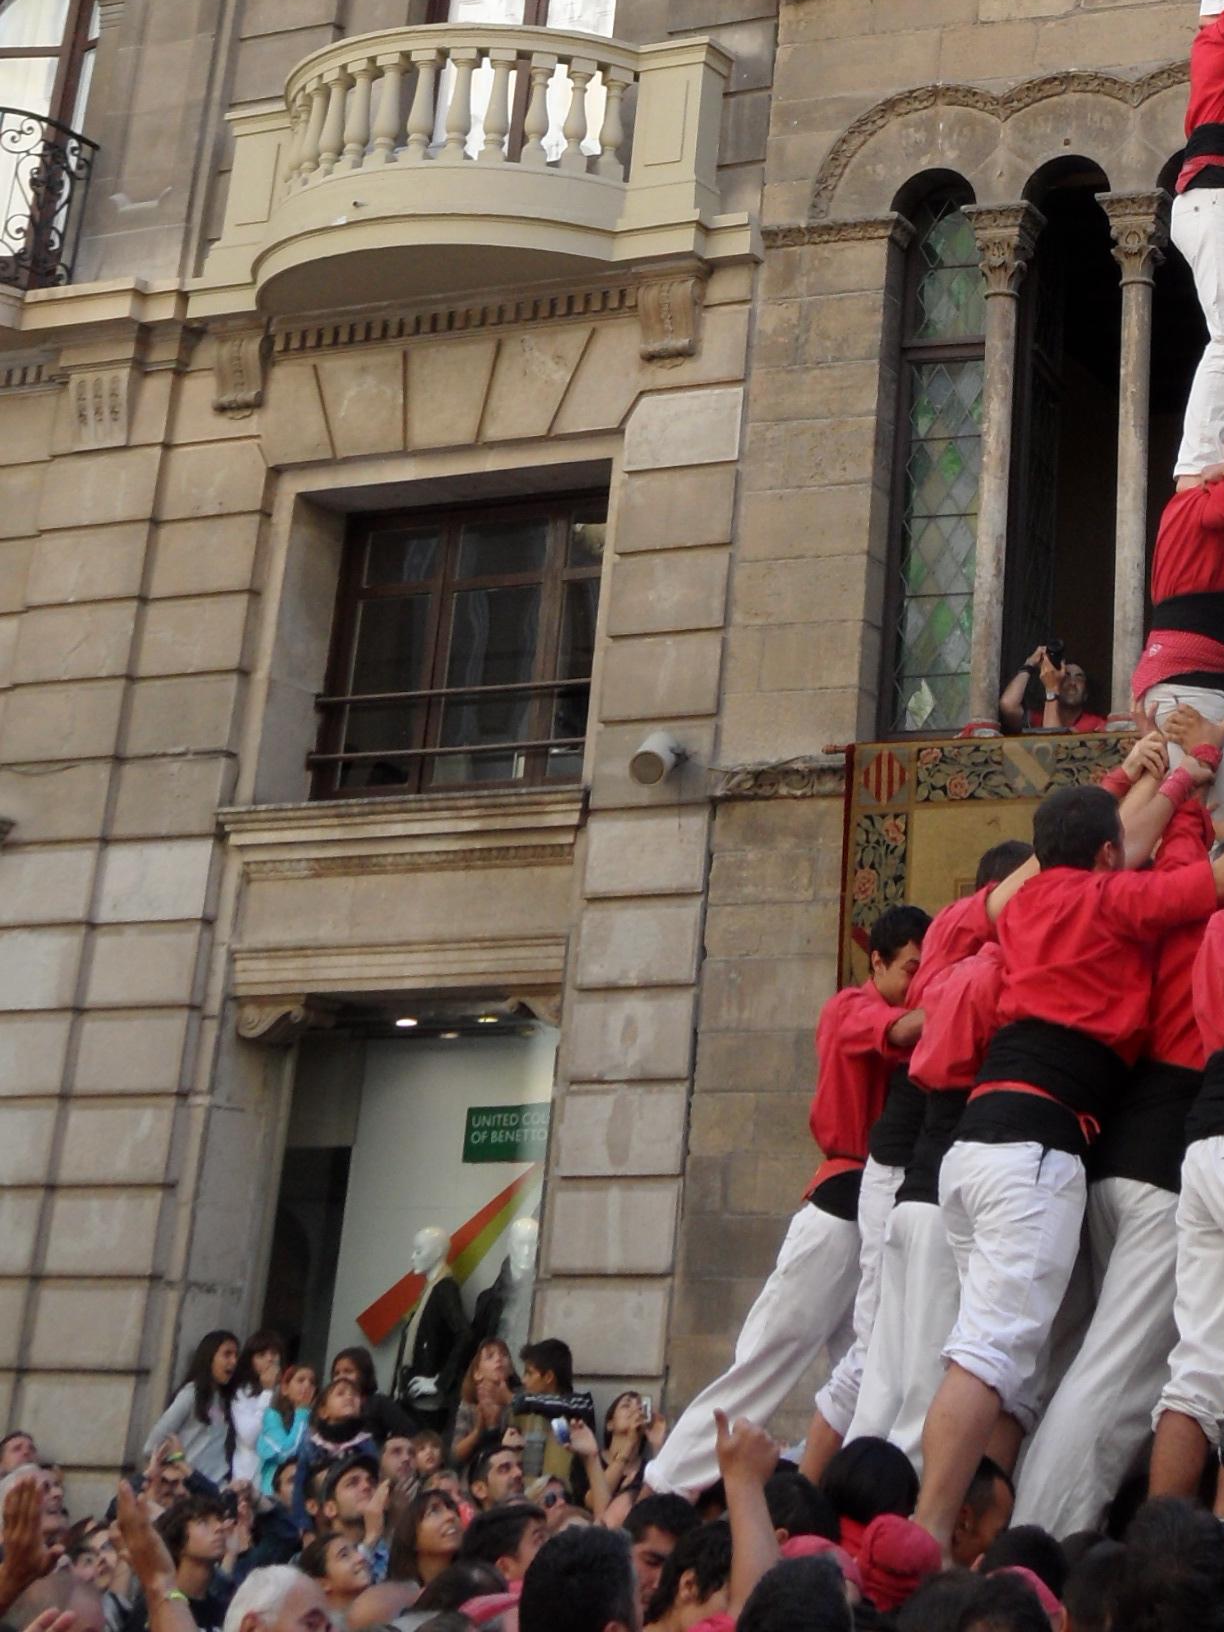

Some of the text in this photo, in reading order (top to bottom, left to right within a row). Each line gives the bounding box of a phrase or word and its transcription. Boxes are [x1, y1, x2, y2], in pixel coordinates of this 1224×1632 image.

[471, 1111, 550, 1128] UNITED COL
[471, 1130, 488, 1144] OF
